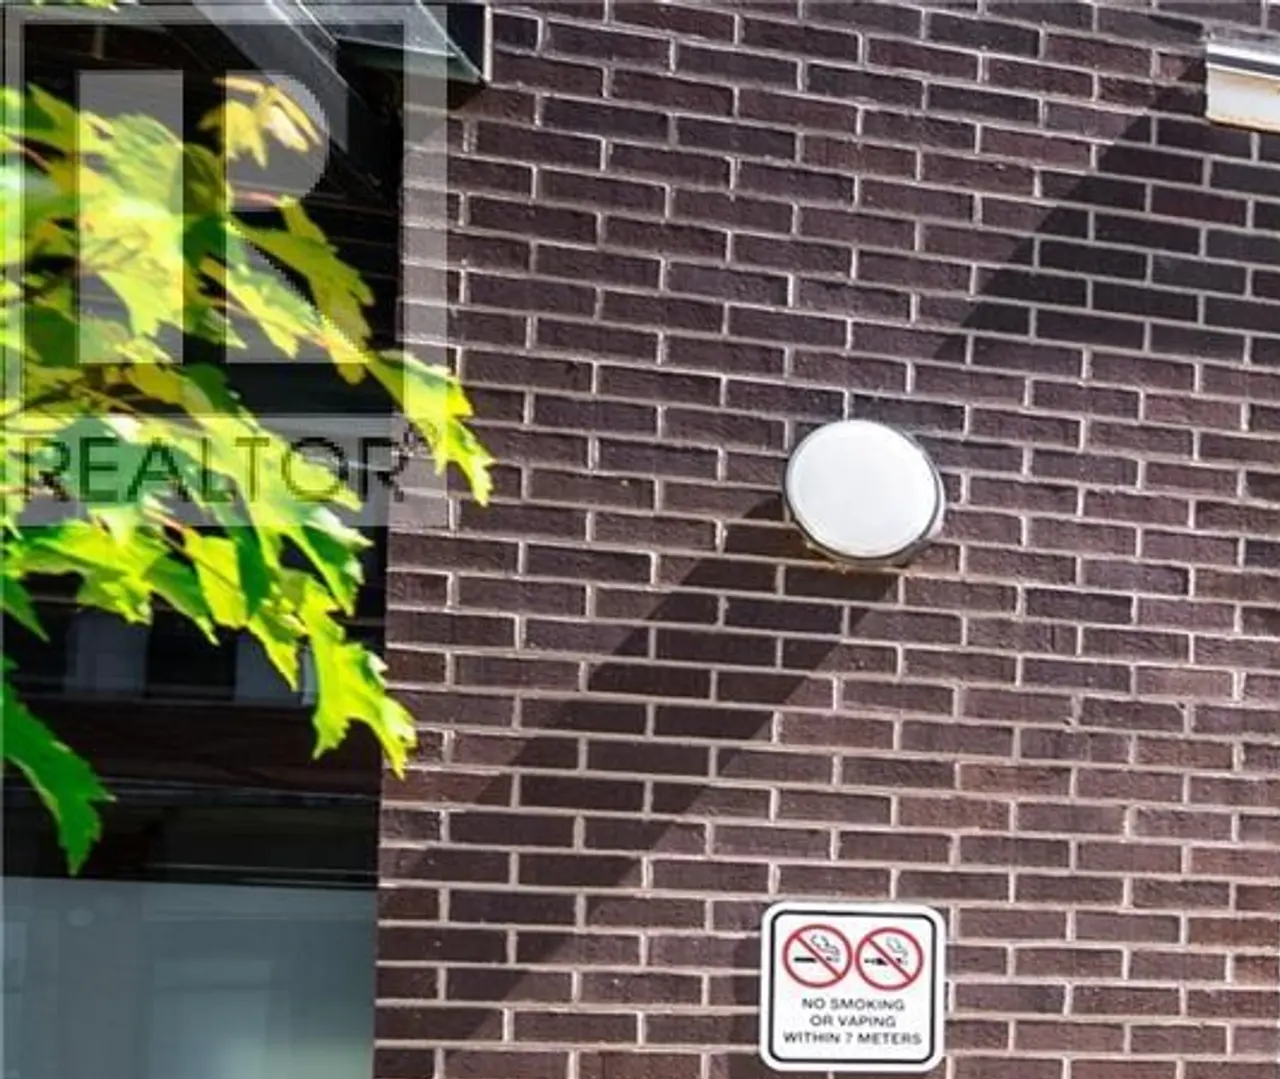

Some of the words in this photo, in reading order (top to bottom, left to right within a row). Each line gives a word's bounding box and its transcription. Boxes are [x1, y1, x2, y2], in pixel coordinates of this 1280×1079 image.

[802, 998, 826, 1010] NO
[830, 998, 905, 1011] SMOKING
[809, 1014, 833, 1027] OR
[838, 1015, 896, 1028] VAPING
[783, 1031, 840, 1044] WITHIN
[845, 1032, 853, 1044] 7
[857, 1032, 922, 1045] METERS
